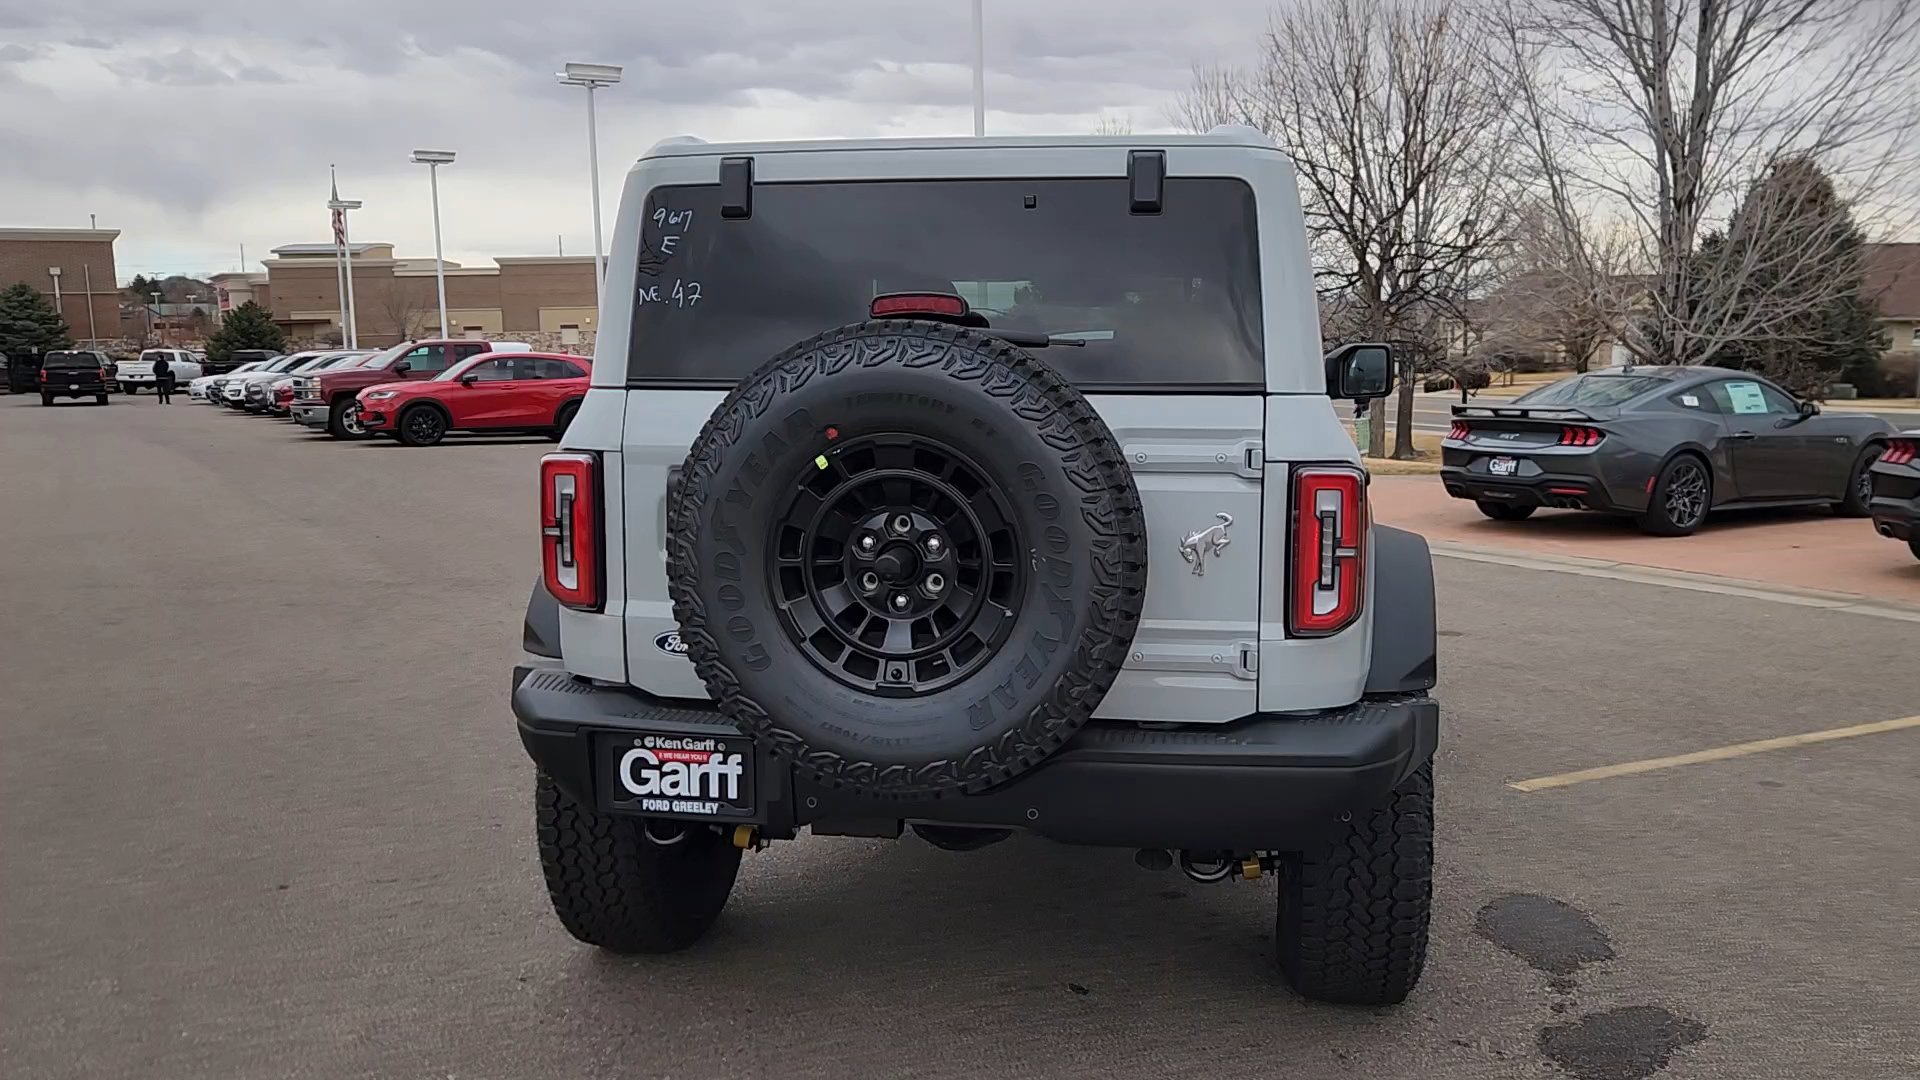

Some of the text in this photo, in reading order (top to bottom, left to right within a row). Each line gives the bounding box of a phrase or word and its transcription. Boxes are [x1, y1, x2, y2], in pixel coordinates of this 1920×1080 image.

[653, 207, 693, 232] 9617
[661, 236, 680, 254] E
[1490, 459, 1517, 473] Garff
[665, 634, 689, 652] For
[656, 737, 715, 751] Ken Garff
[673, 752, 689, 760] HEAR
[619, 748, 743, 800] Garff
[642, 798, 719, 815] FORD GREELEY
